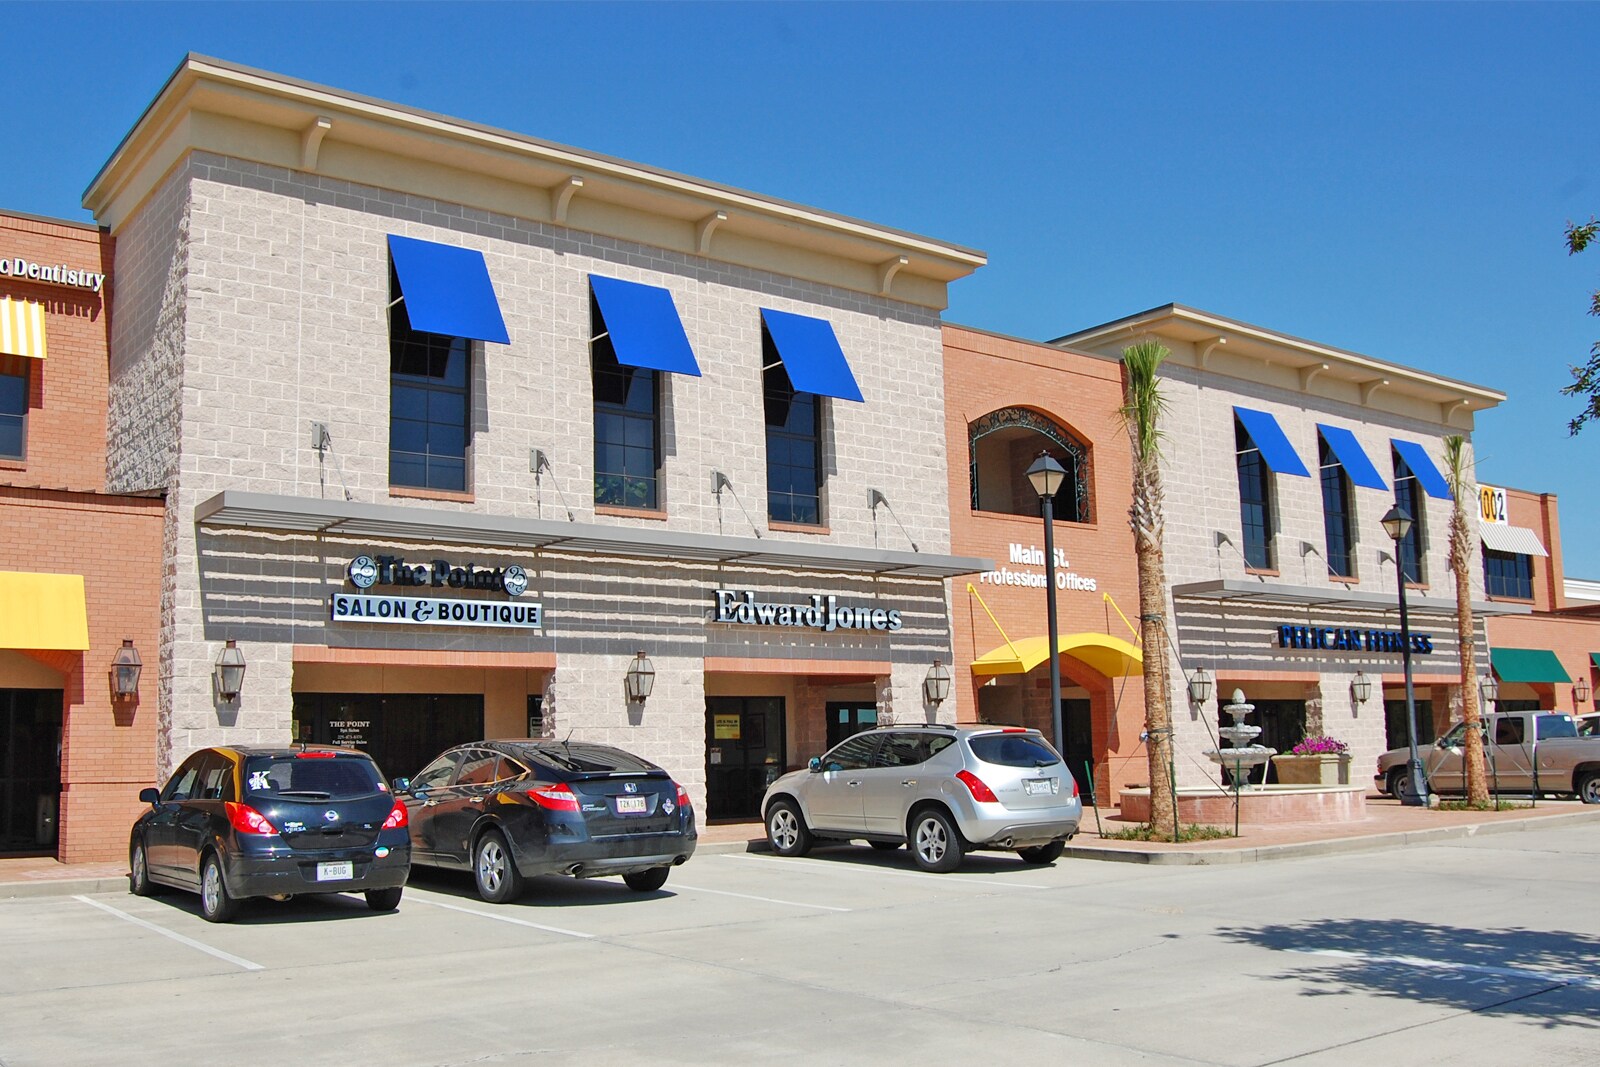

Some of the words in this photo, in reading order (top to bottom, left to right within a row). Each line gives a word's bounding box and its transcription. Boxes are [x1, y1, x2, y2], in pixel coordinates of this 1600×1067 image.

[13, 257, 105, 292] Dentistry
[1009, 543, 1044, 566] Main
[376, 555, 427, 586] The
[431, 559, 502, 591] Point
[1056, 572, 1096, 592] Offices
[336, 598, 407, 618] SALON
[412, 600, 434, 622] &
[438, 603, 537, 623] BOUTIQUE
[712, 589, 823, 628] Edward
[822, 595, 902, 632] Jones
[323, 866, 347, 876] K-BUG
